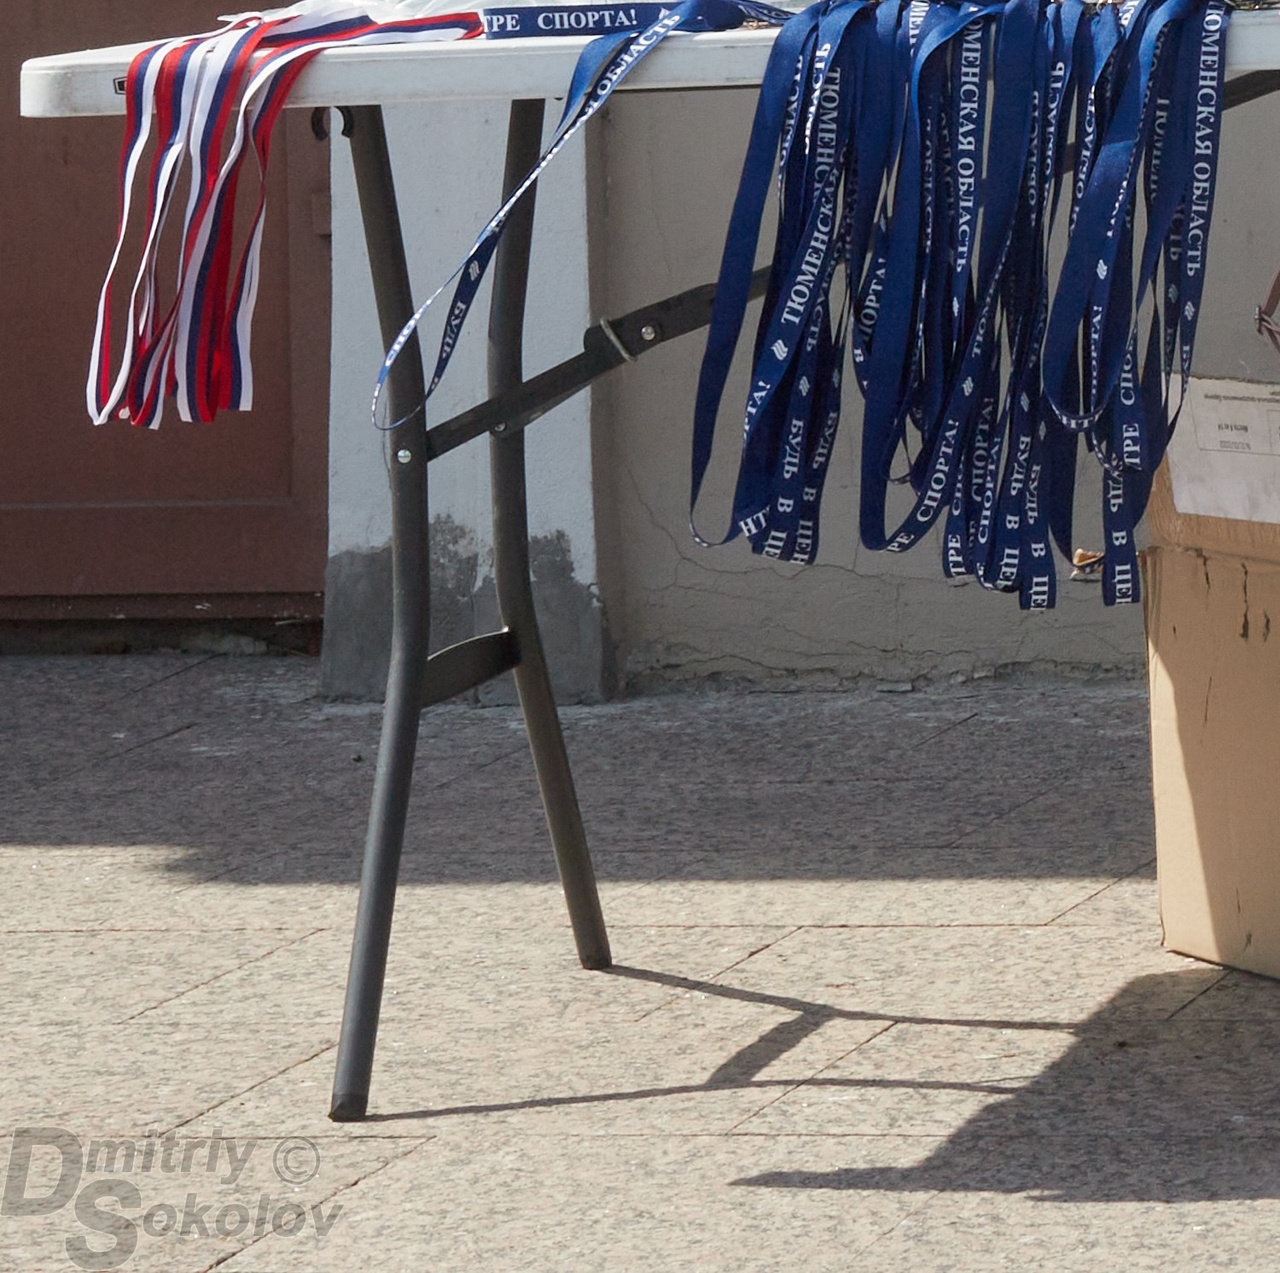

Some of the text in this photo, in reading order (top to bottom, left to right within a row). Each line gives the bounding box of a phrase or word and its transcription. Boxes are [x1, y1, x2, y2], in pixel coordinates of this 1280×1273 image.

[537, 9, 638, 30] СПОРТА!
[597, 14, 680, 97] ОБЛАСТЬ
[956, 156, 975, 272] ОБЛАСТЬ
[1187, 162, 1211, 276] ОБЛАСТЬ
[784, 418, 804, 480] БУДЬ
[917, 419, 960, 522] СПОРТА!
[1010, 436, 1032, 496] БУДЬ
[777, 496, 794, 514] В
[1006, 514, 1020, 530] В
[1025, 465, 1042, 525] БУДЬ
[1031, 543, 1046, 558] В
[1112, 531, 1128, 546] В
